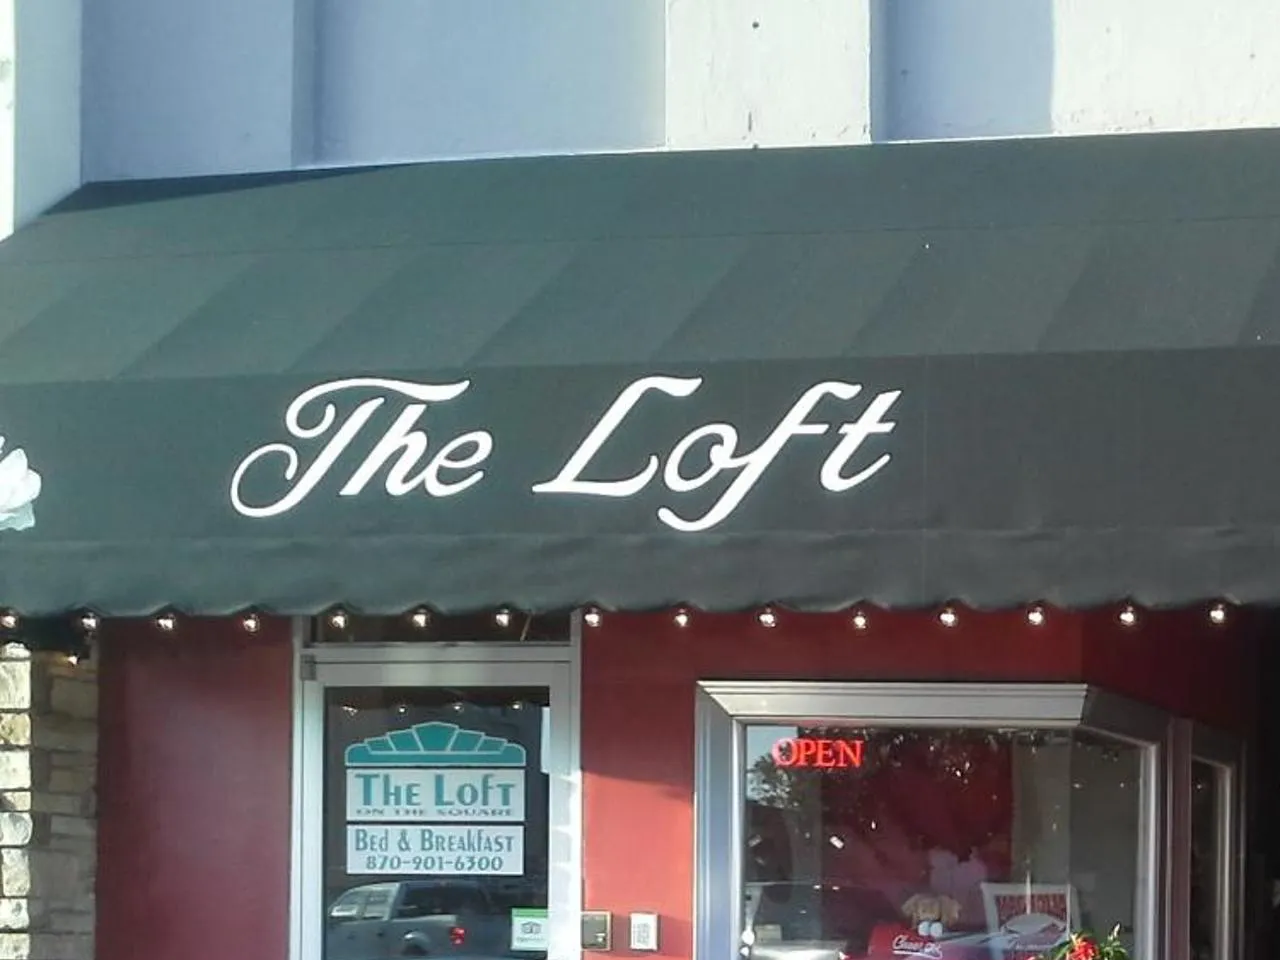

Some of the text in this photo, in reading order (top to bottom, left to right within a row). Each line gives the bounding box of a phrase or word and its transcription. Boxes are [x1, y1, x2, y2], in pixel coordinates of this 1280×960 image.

[231, 375, 902, 532] The Loft
[771, 737, 864, 768] OPEN
[398, 829, 412, 852] &
[366, 855, 504, 872] 870-901-6300
